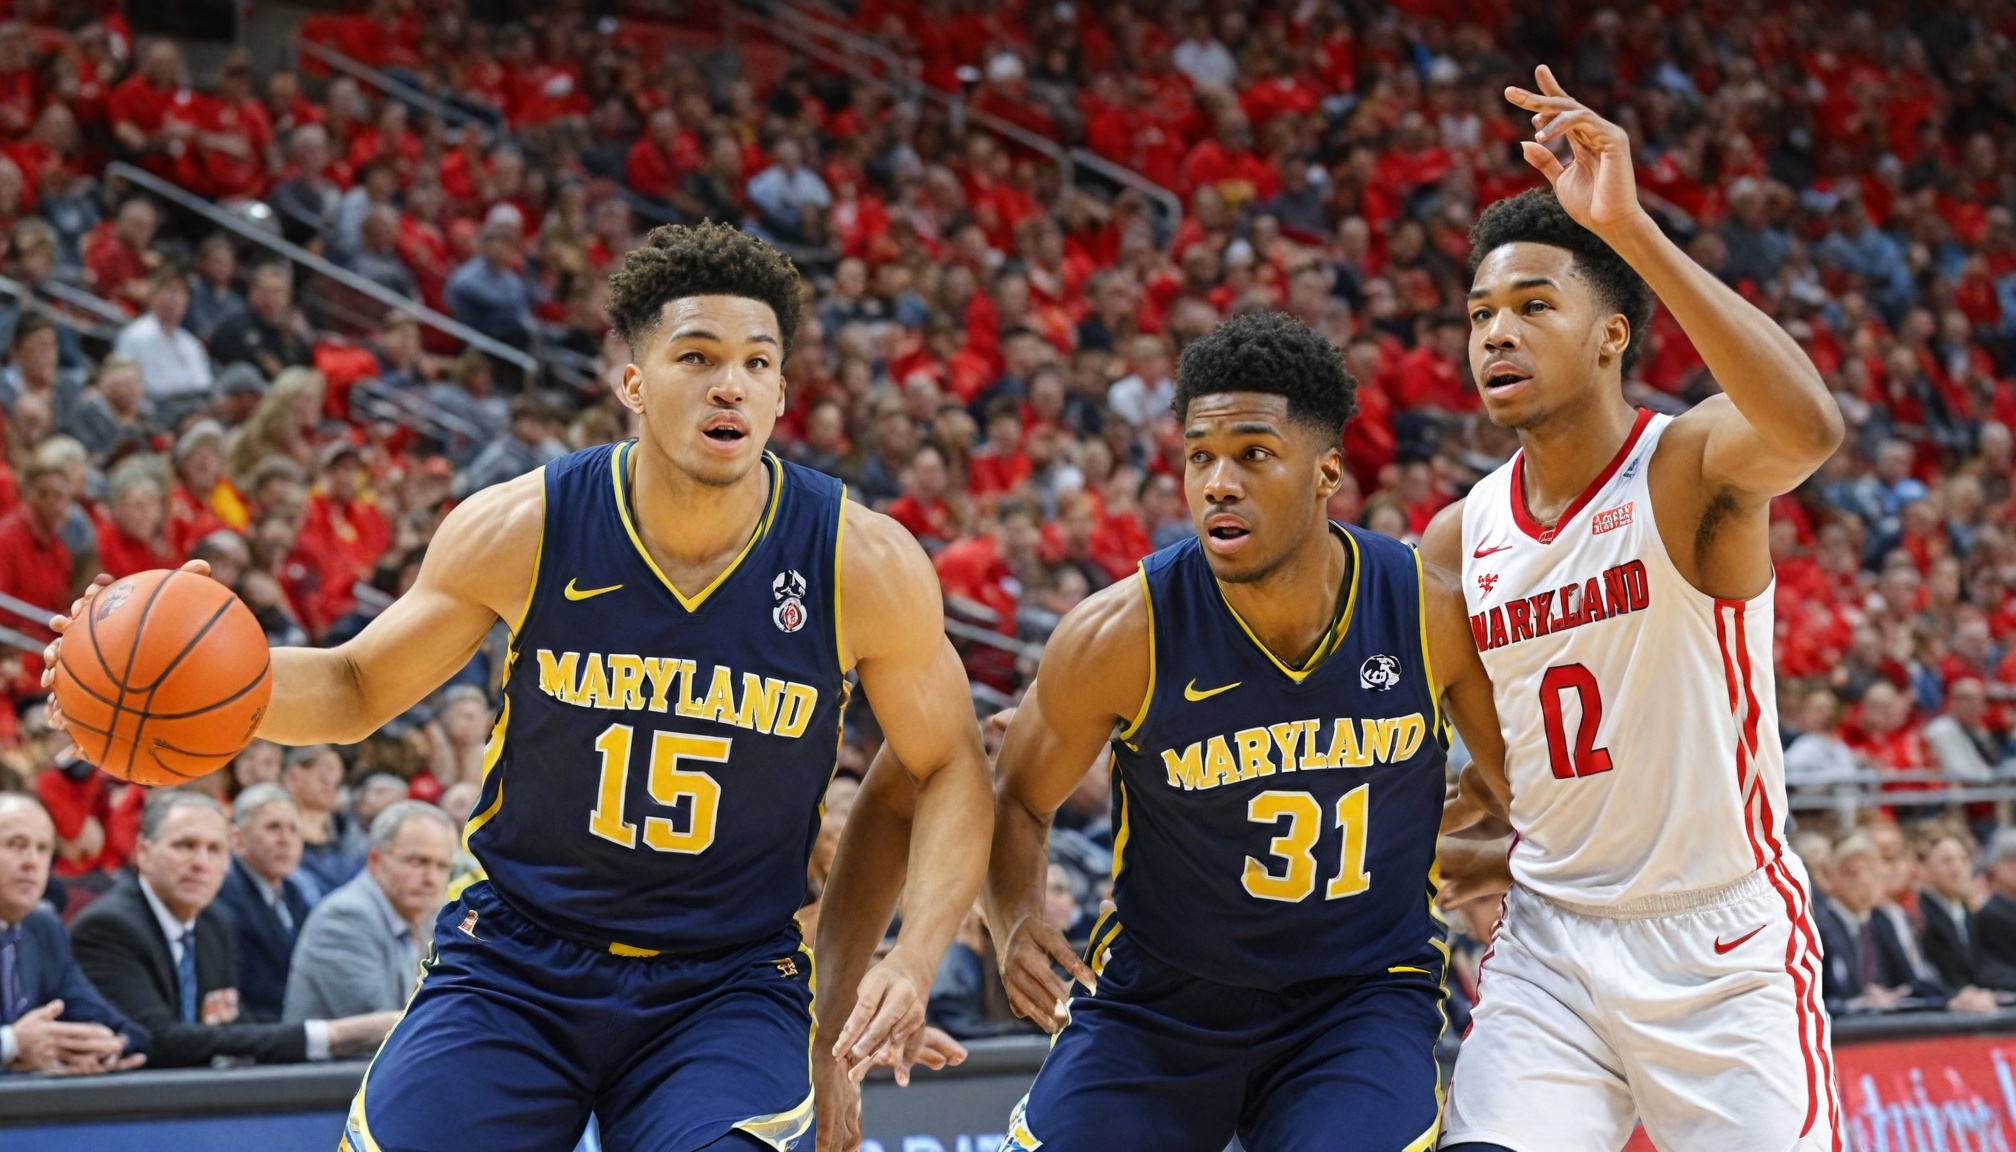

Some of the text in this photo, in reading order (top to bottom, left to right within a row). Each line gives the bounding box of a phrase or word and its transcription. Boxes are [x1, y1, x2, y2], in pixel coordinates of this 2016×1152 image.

[537, 649, 818, 738] MARYLAND
[589, 723, 733, 855] 15
[1161, 712, 1426, 790] MARYLAND
[1241, 783, 1371, 903] 31
